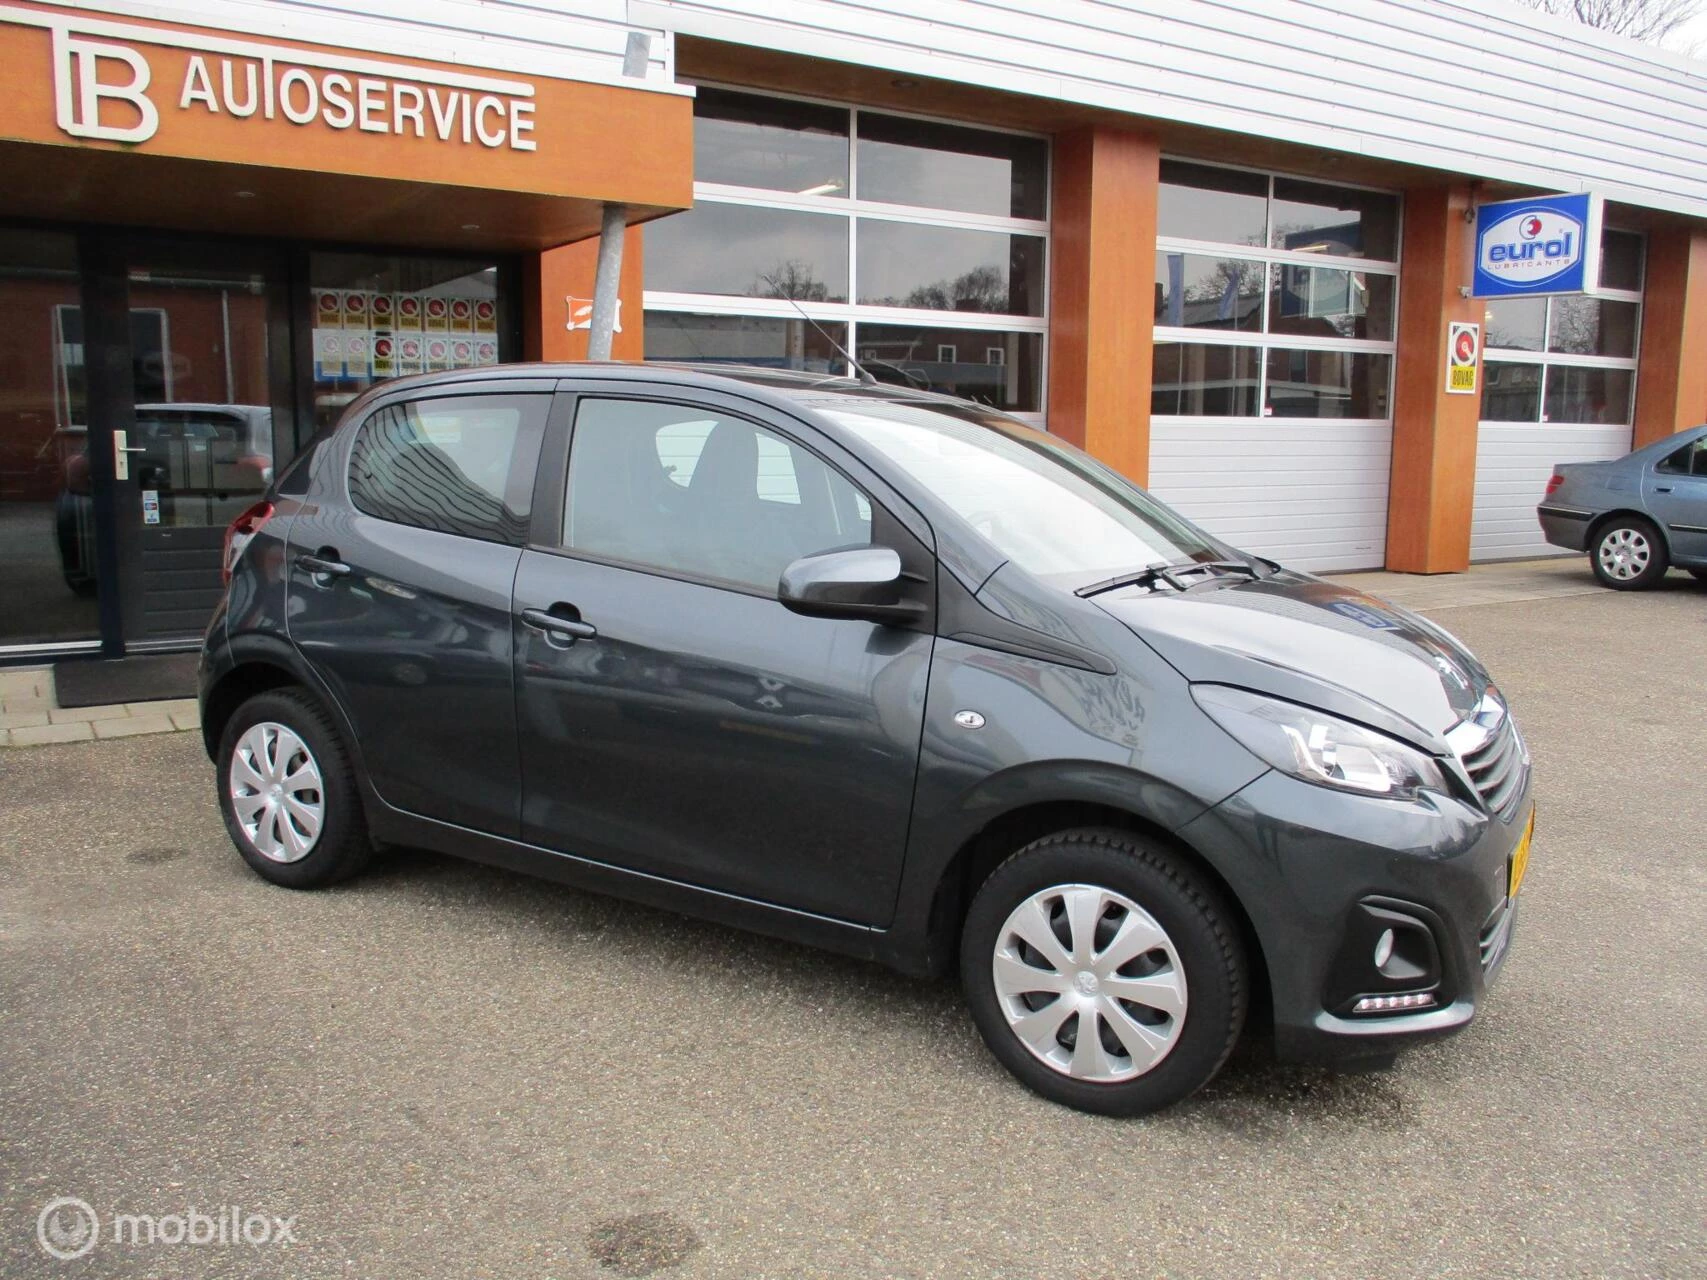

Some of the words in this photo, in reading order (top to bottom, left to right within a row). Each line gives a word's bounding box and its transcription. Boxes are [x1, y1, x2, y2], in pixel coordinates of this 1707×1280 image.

[179, 44, 537, 151] AUTOSERVICE
[1489, 231, 1573, 262] eurol
[1487, 258, 1570, 270] LUBRICANTS
[1452, 369, 1474, 386] BOVAG
